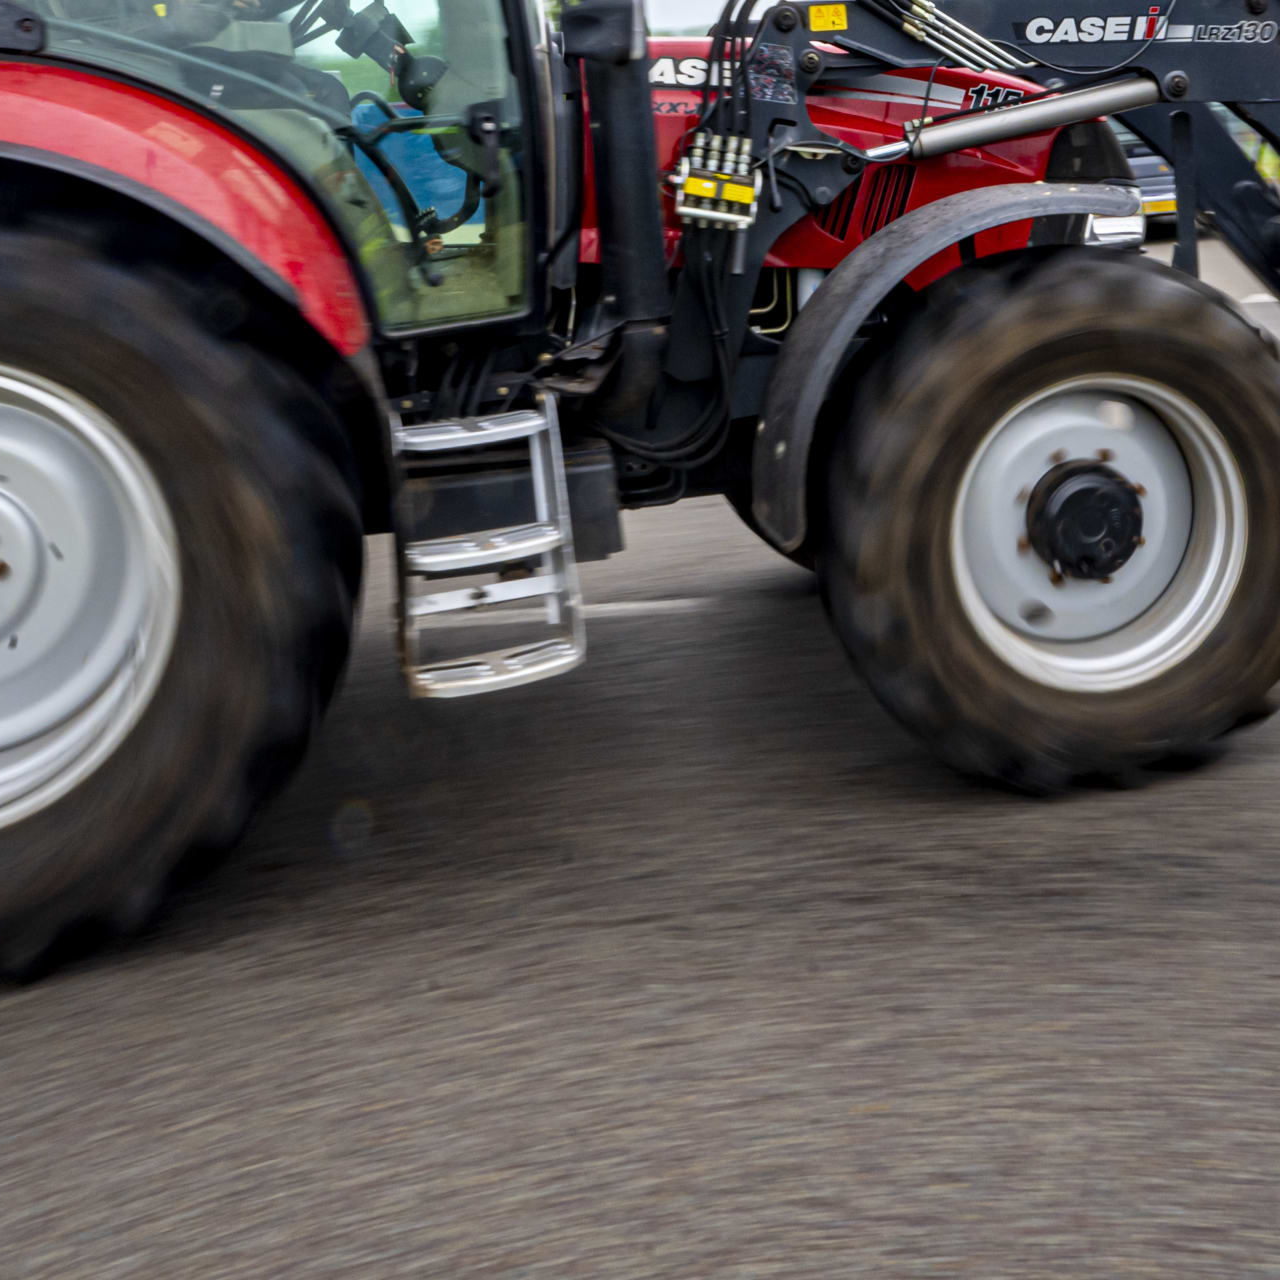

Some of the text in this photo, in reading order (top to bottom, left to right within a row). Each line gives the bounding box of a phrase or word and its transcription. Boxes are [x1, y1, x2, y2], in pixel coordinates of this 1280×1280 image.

[1025, 17, 1132, 44] CASE
[1194, 20, 1279, 44] LRZ130
[648, 57, 741, 87] ASE
